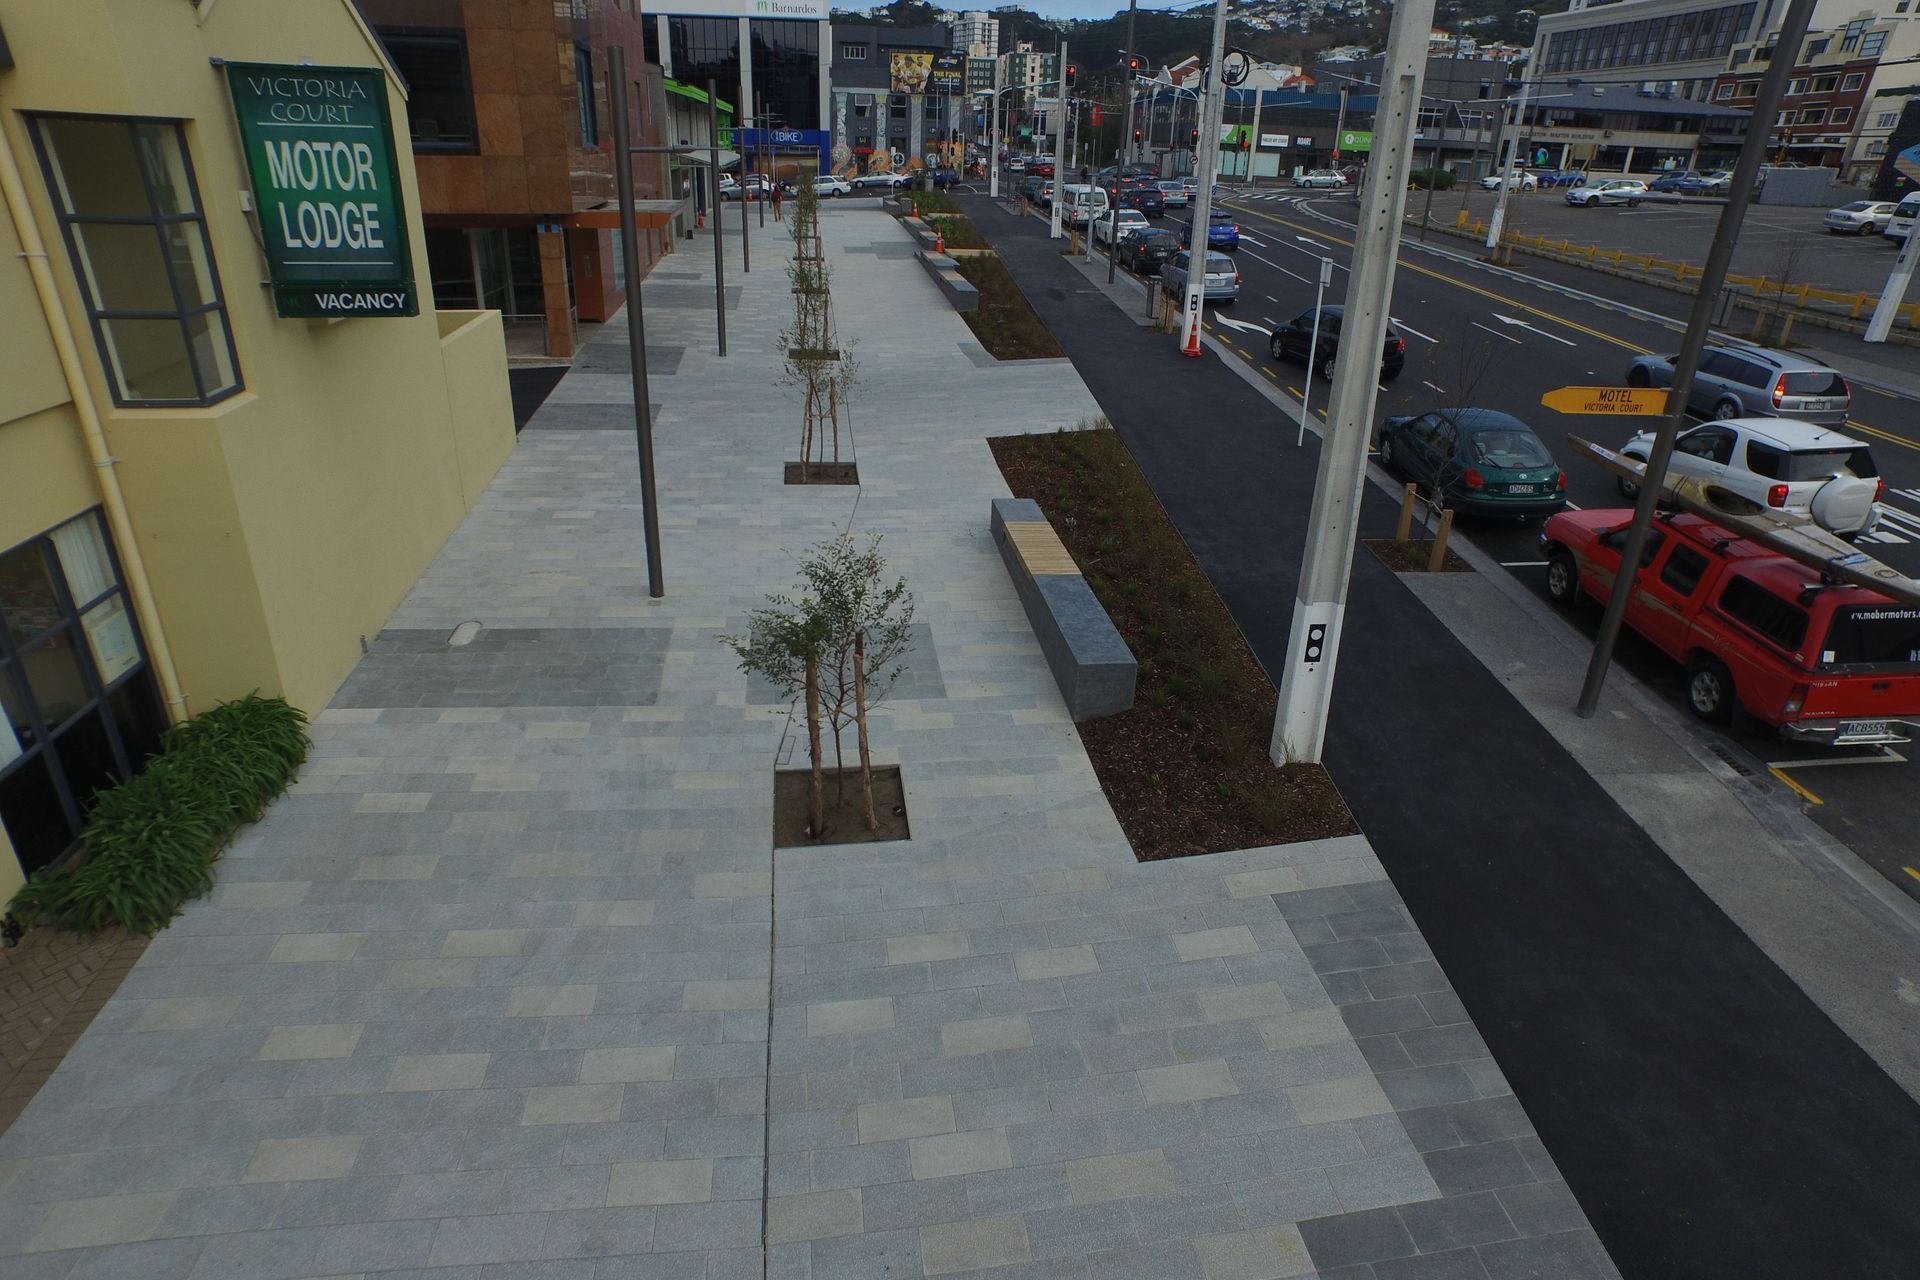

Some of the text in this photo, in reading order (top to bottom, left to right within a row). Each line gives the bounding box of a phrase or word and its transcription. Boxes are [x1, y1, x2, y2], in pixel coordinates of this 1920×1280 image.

[772, 2, 817, 14] Barnardos
[247, 77, 366, 99] VICTORIA
[270, 102, 353, 123] COURT
[779, 131, 799, 142] BIKE
[264, 140, 378, 192] MOTOR
[278, 201, 384, 250] LODGE
[315, 293, 406, 310] VACANCY
[1598, 389, 1633, 403] MOTEL
[1584, 403, 1643, 412] VICTORIA COURT
[1848, 723, 1886, 734] ACB555
